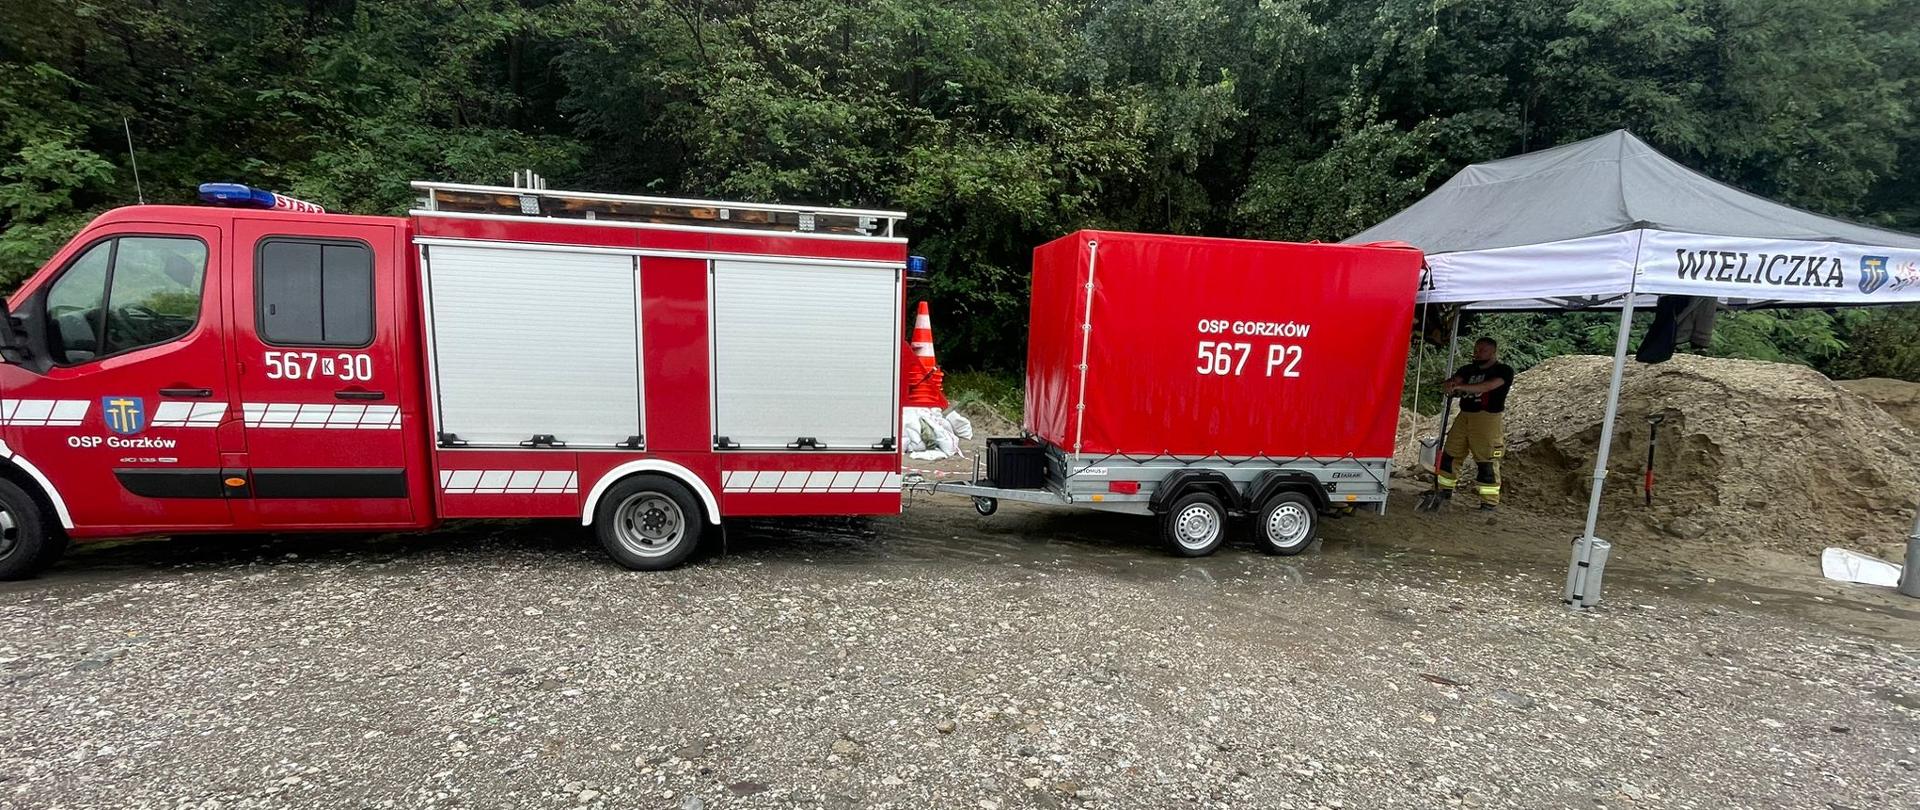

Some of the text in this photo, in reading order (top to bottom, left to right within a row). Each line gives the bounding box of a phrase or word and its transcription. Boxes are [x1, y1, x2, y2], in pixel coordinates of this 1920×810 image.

[1676, 248, 1844, 288] WIELICZKA
[1197, 319, 1311, 337] OSP GORZKÓW
[264, 351, 372, 381] 567 K 30
[1196, 340, 1303, 377] 567 P2
[67, 436, 176, 448] OSP Gorzków
